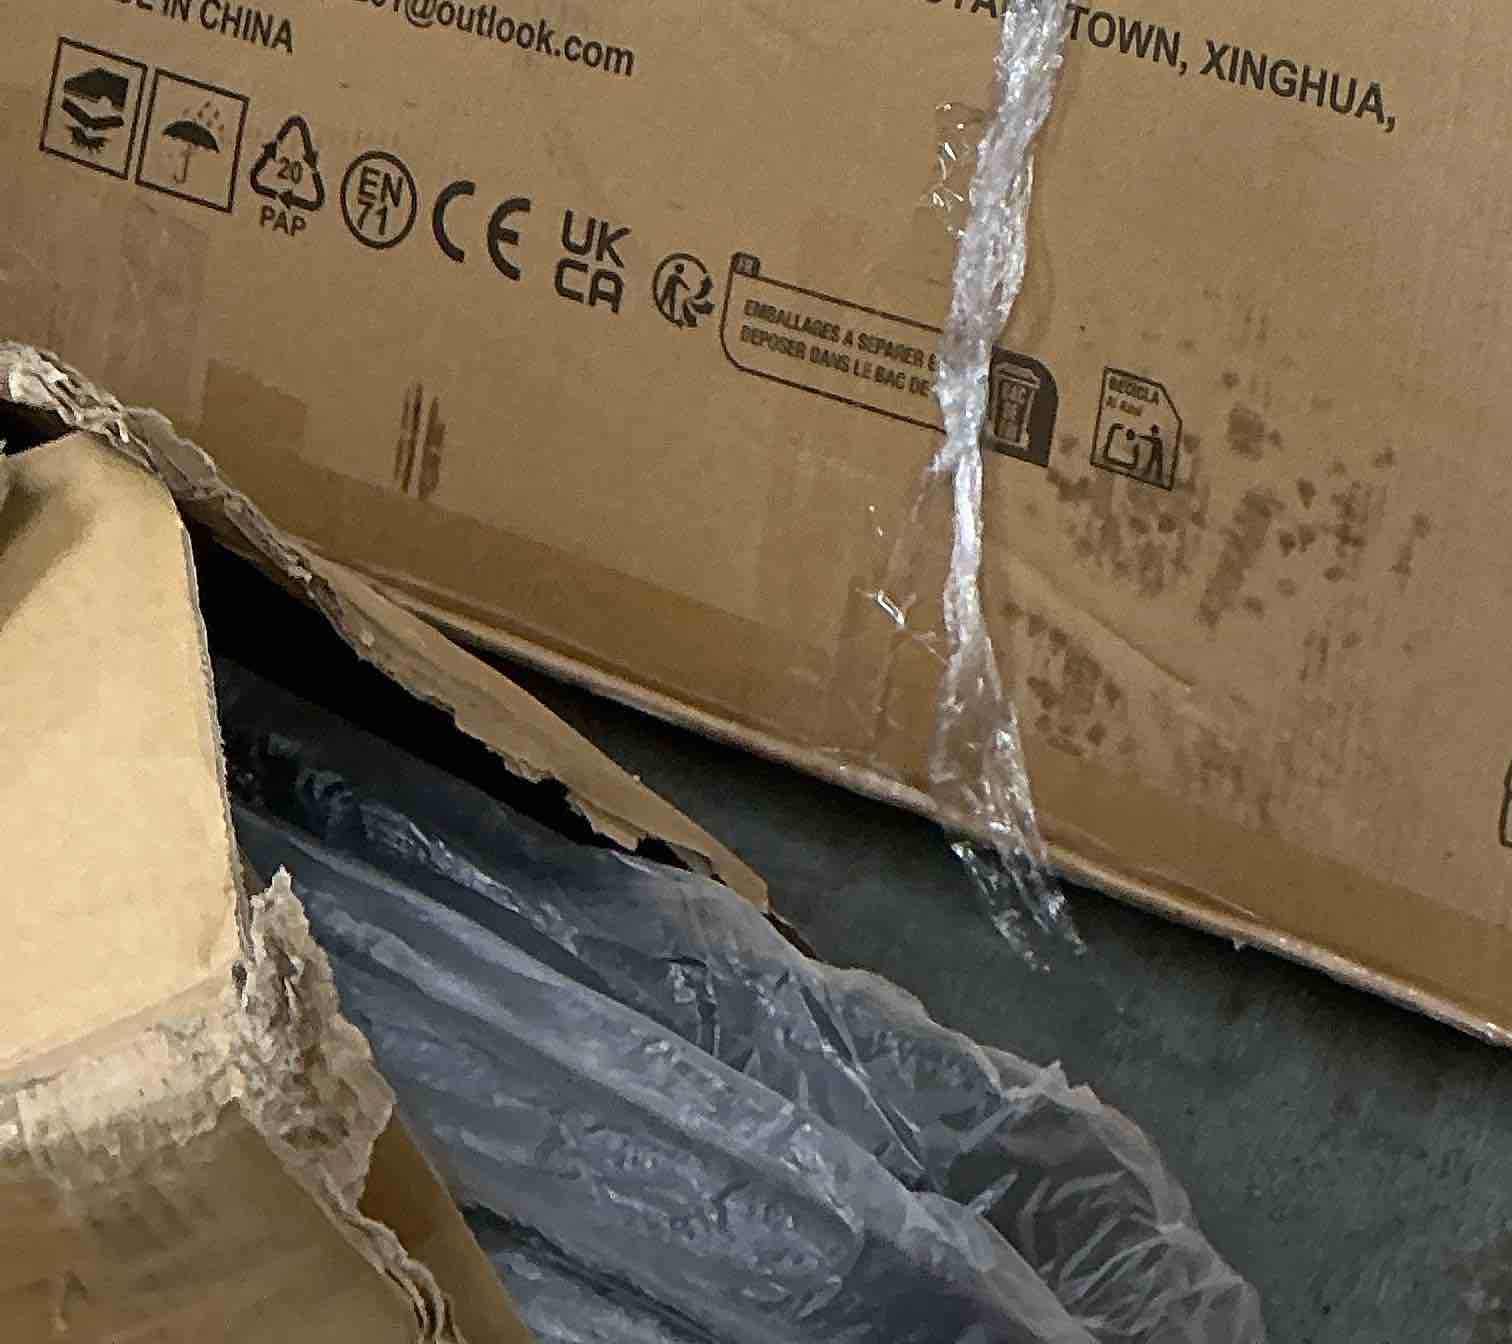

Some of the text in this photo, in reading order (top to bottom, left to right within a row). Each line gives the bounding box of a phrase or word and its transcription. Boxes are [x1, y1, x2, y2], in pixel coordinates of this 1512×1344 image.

[1066, 3, 1188, 75] TOWN,
[1201, 40, 1397, 132] XINGHUA,
[276, 157, 302, 185] 20
[358, 167, 403, 207] EN
[259, 207, 307, 236] PAP
[357, 202, 387, 235] 71
[432, 180, 531, 281] CE
[561, 210, 631, 269] UK
[554, 256, 624, 313] CA
[744, 300, 840, 342] EMBALLAGES
[854, 359, 872, 379] LE
